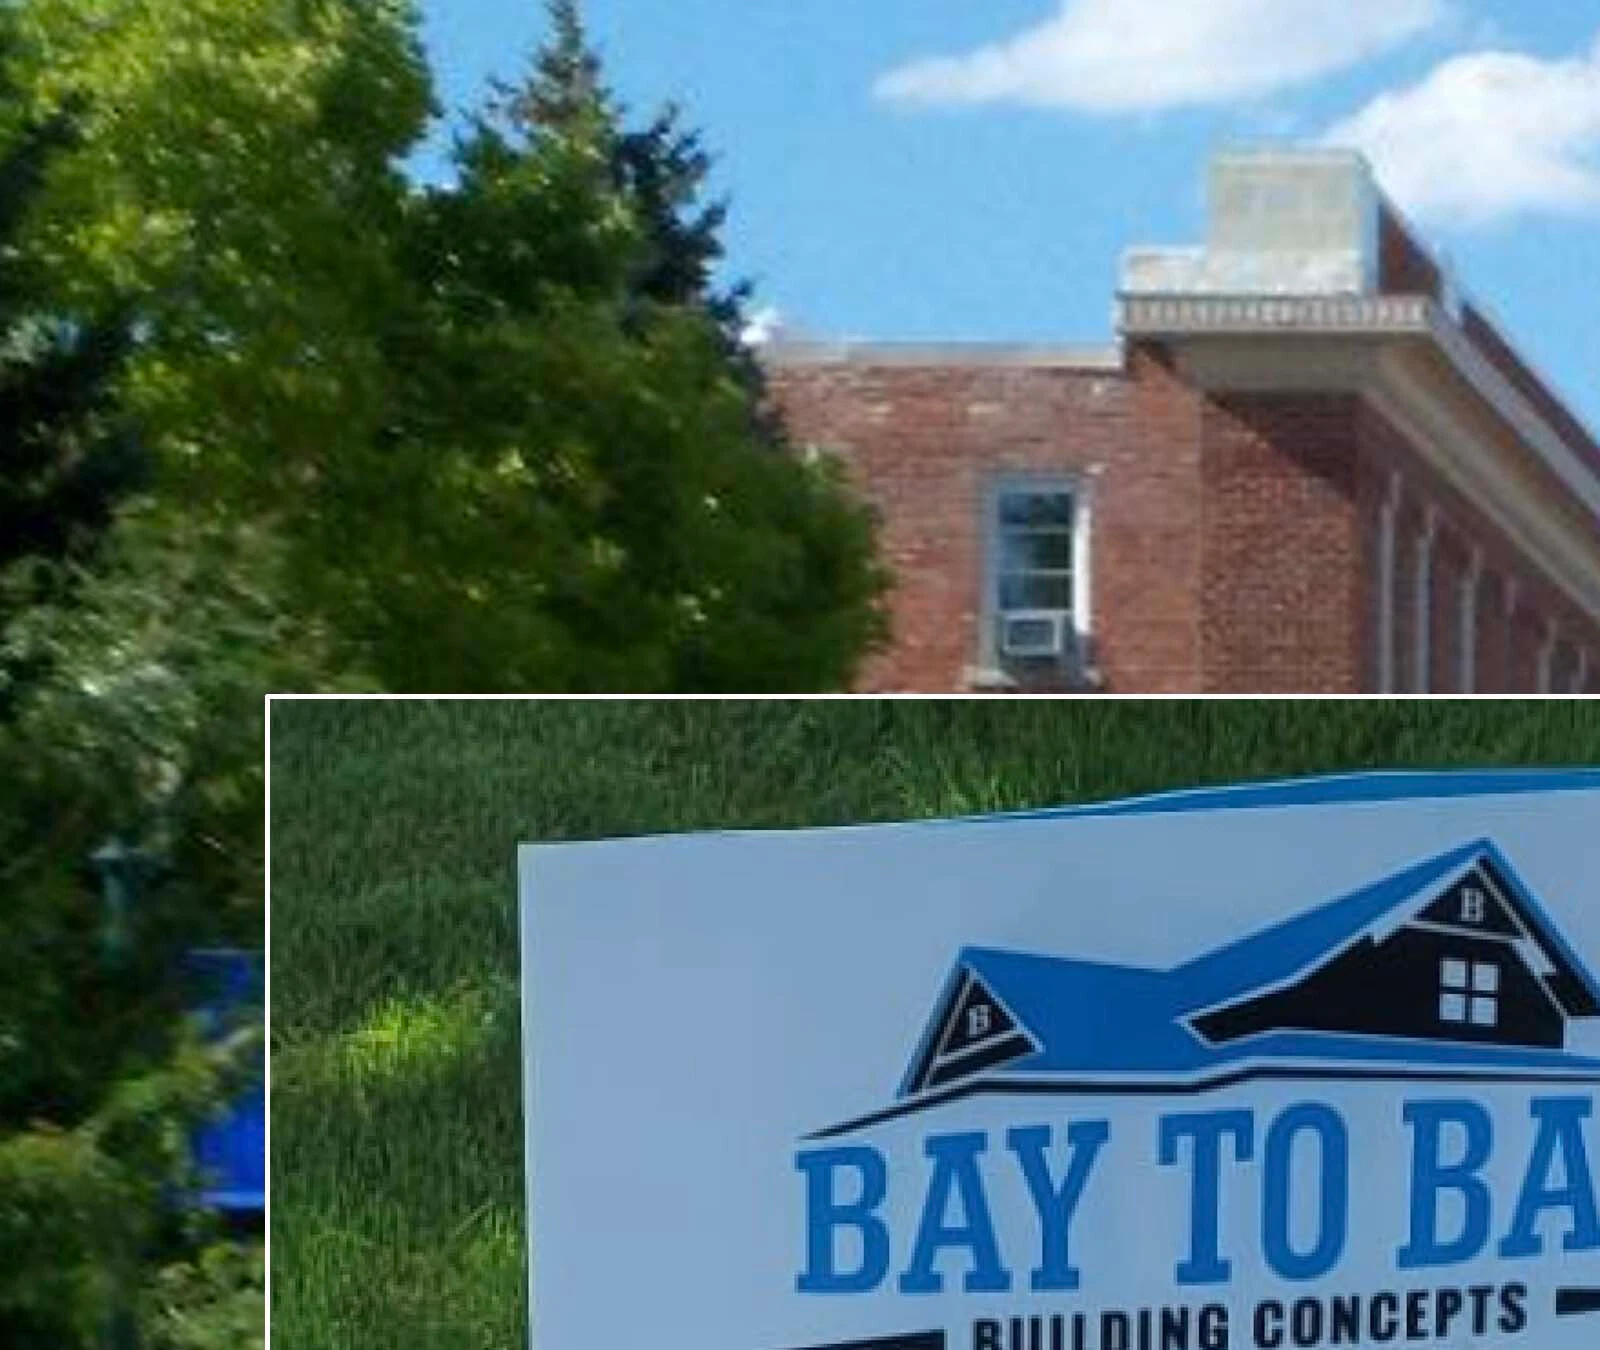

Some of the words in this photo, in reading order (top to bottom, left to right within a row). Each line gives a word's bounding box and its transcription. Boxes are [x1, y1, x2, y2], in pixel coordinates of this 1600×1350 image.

[1461, 888, 1484, 922] B
[968, 1004, 989, 1036] B
[794, 1117, 1112, 1297] BAY
[1157, 1100, 1350, 1288] TO
[1252, 1282, 1529, 1350] CONCEPTS
